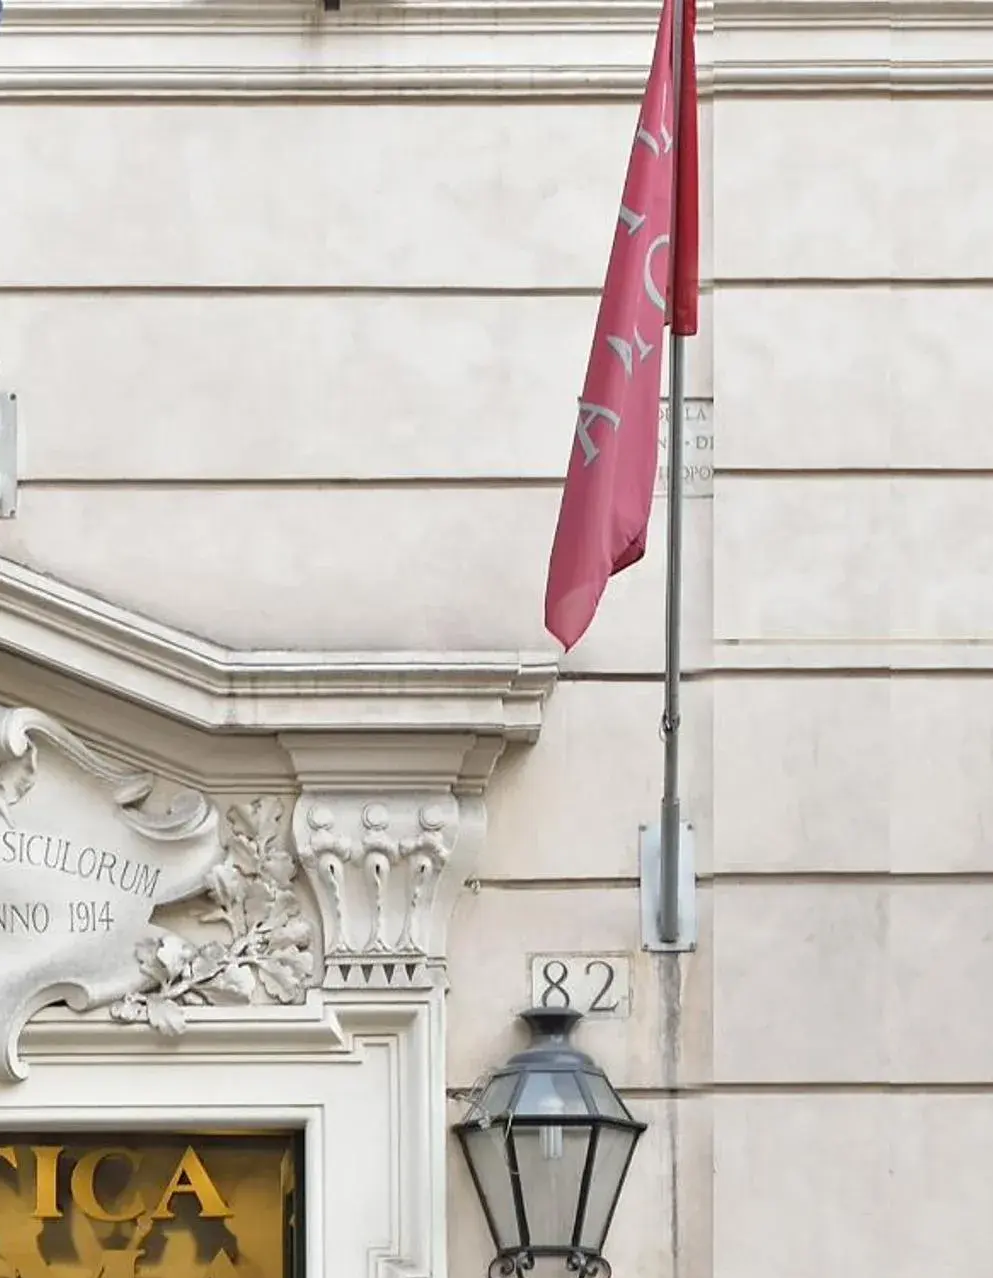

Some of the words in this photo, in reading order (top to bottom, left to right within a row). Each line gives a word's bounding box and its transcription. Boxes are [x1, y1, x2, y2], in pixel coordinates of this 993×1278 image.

[1, 830, 162, 898] SICULORUM
[67, 901, 114, 933] 1914
[542, 960, 620, 1012] 82
